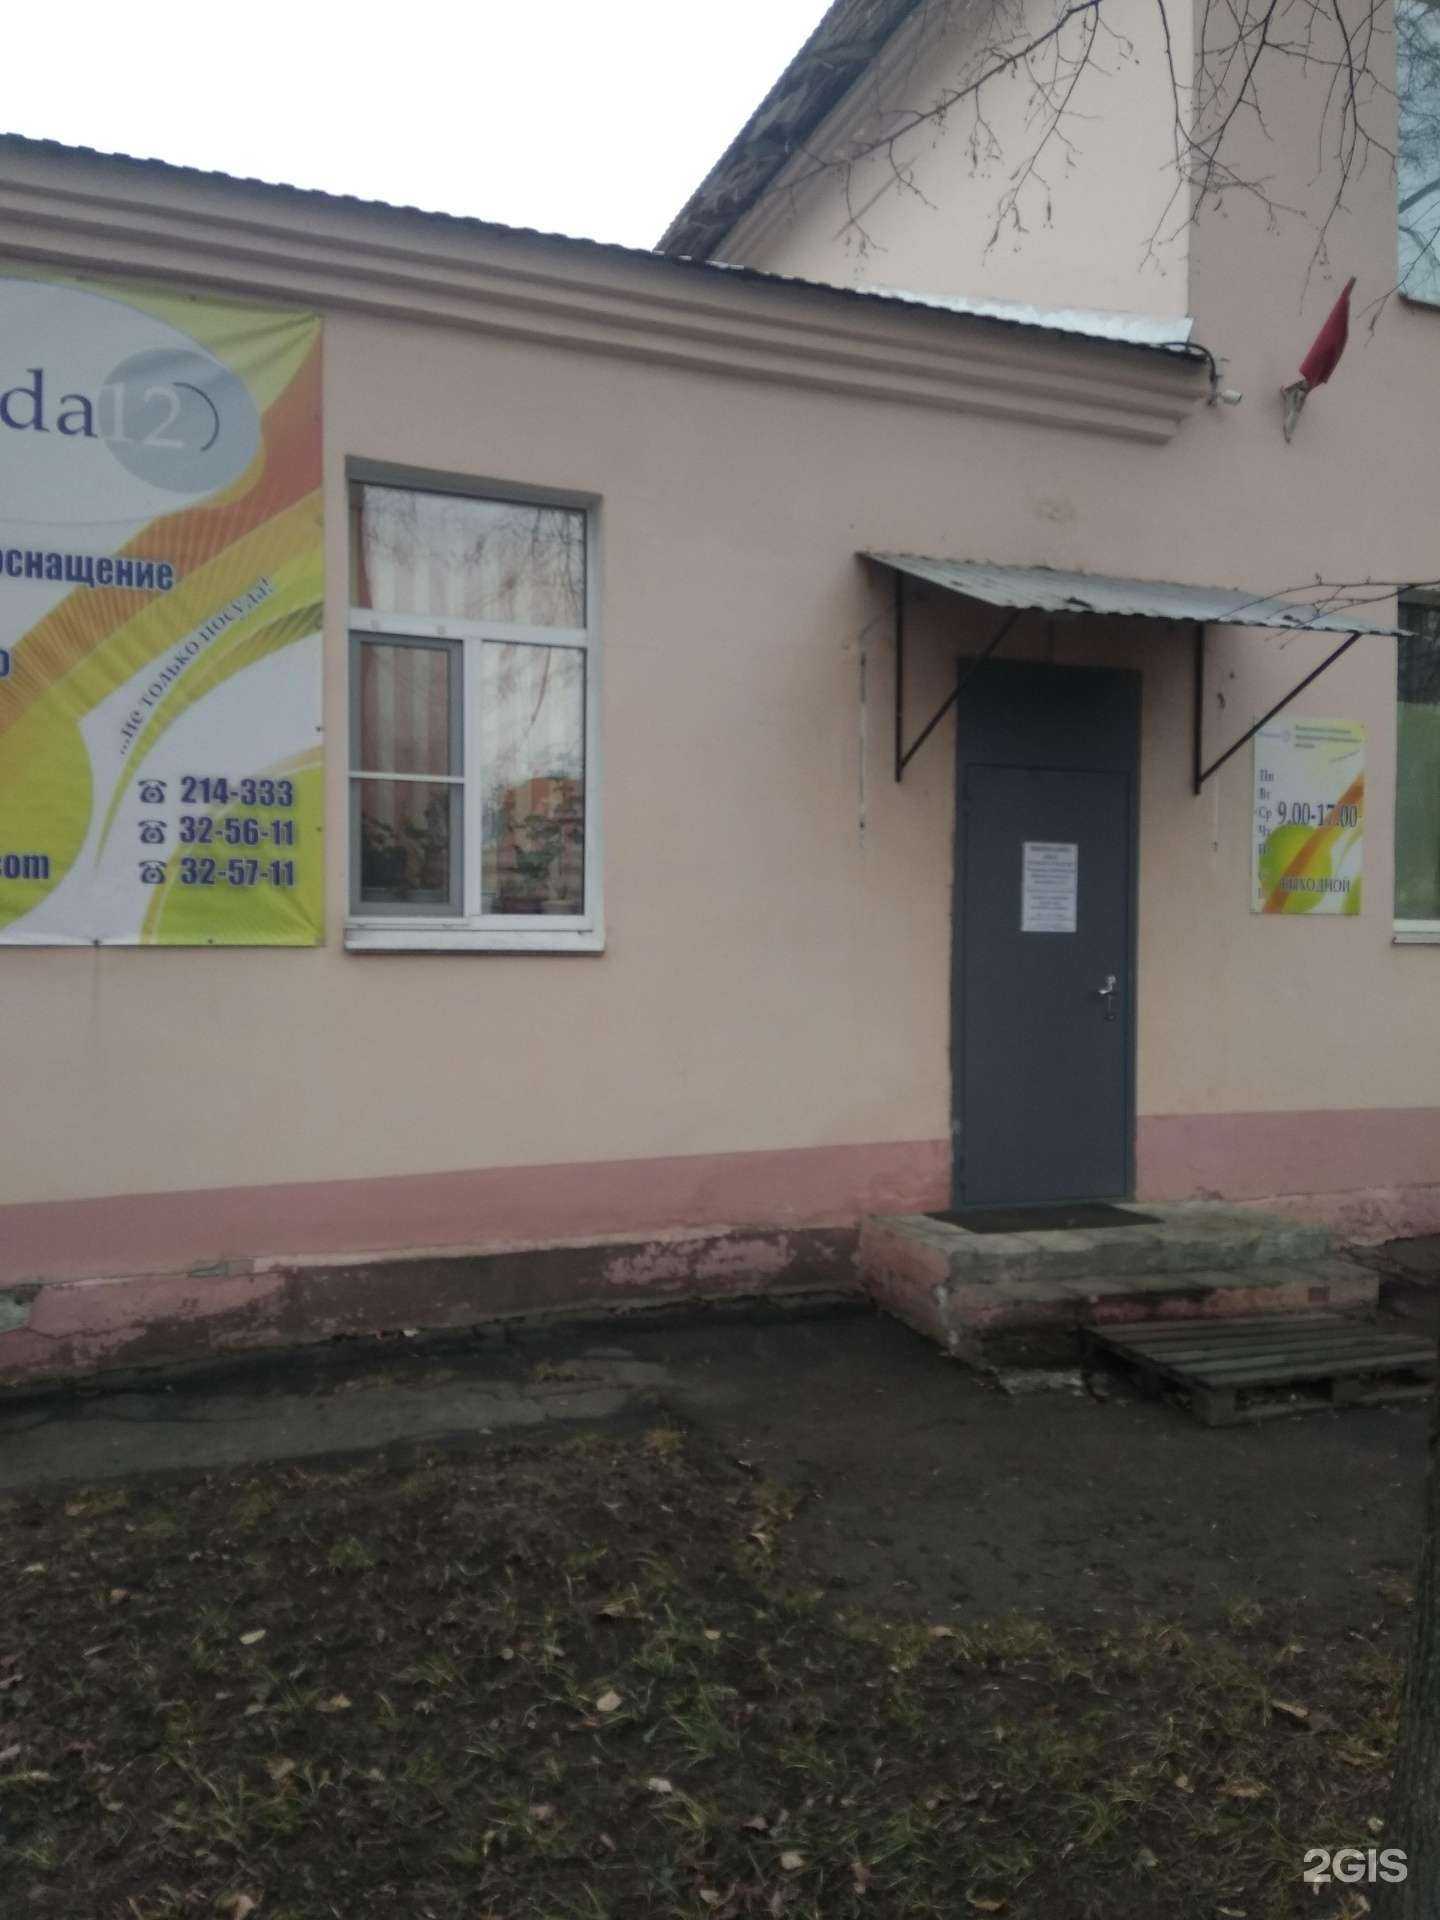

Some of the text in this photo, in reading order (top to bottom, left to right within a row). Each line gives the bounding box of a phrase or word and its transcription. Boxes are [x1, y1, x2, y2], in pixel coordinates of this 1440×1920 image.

[0, 548, 174, 591] снащение
[180, 775, 294, 808] 214-333
[179, 815, 294, 846] 32-56-11
[0, 854, 50, 880] om
[180, 856, 295, 887] 32-57-11
